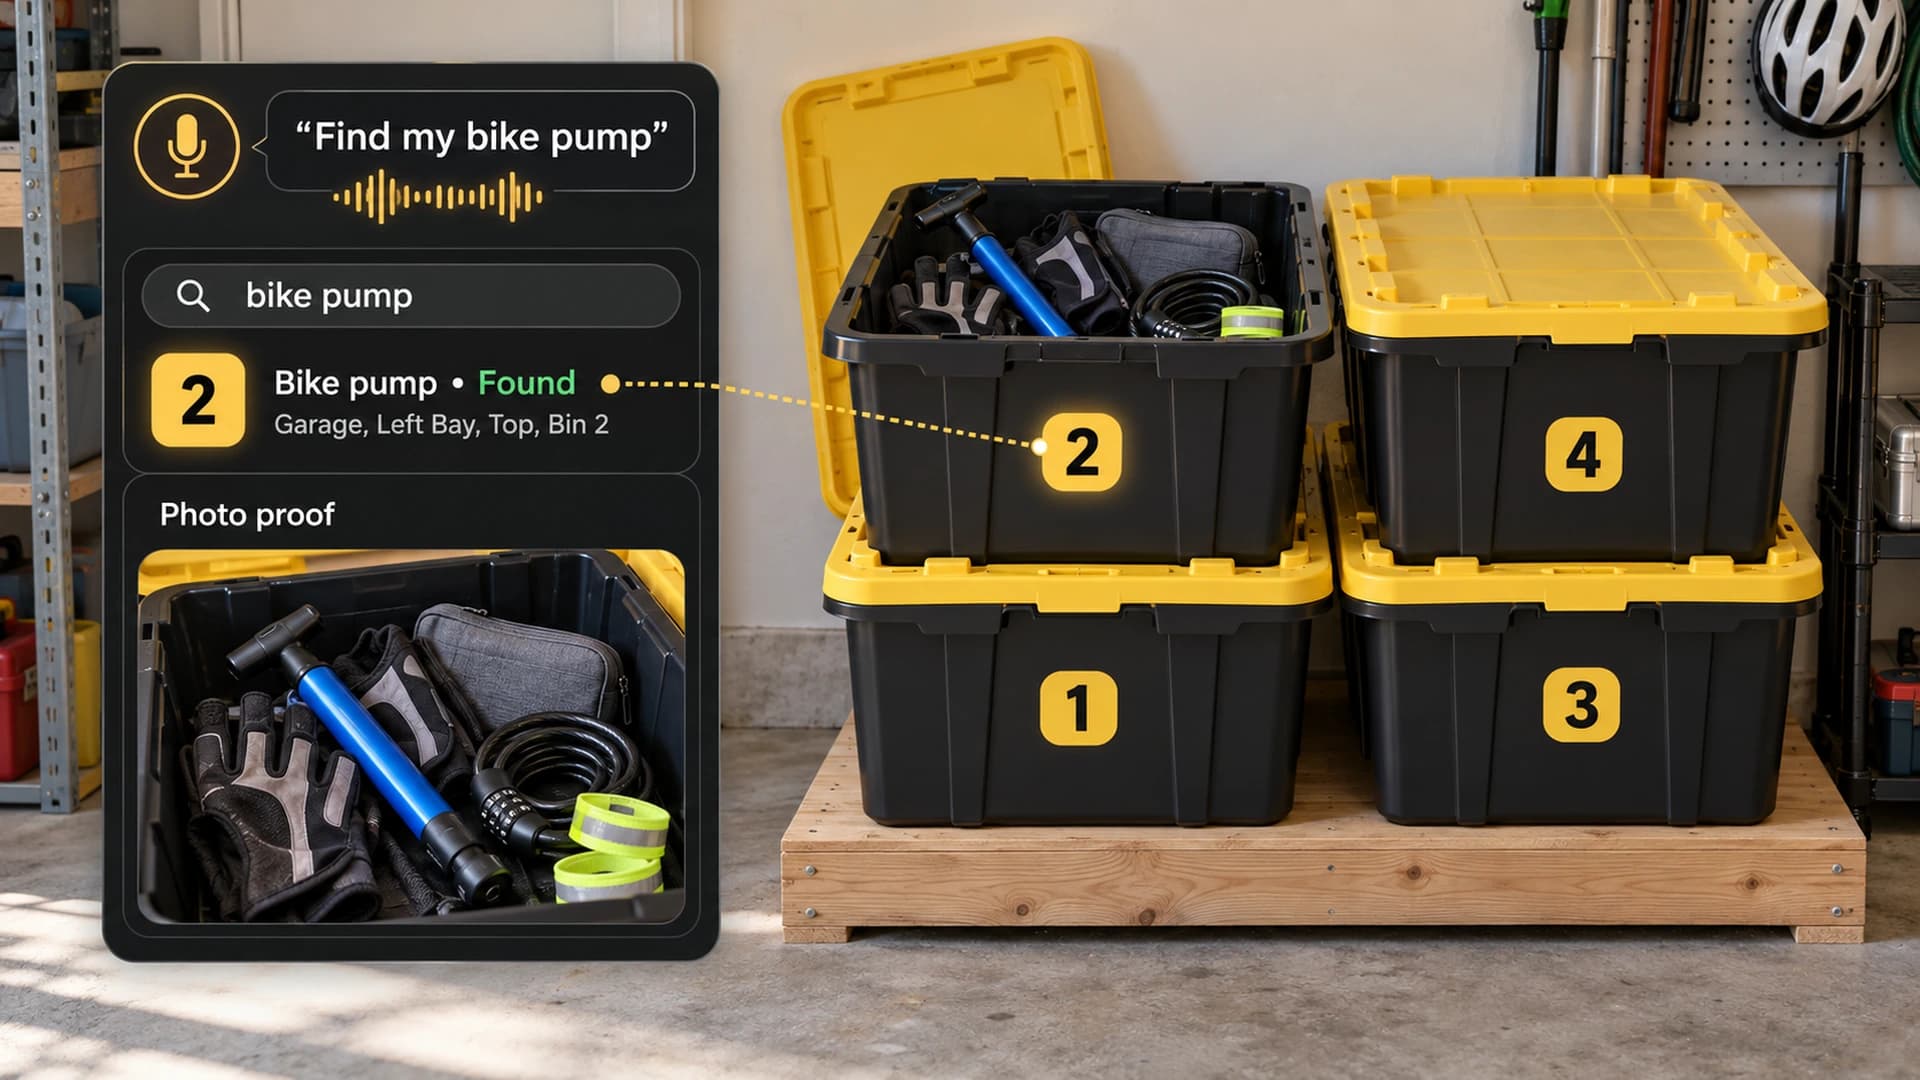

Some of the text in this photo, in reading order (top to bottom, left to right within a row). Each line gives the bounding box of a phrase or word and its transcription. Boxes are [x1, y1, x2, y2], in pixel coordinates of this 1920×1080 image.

[1065, 427, 1100, 477] 2
[1566, 430, 1602, 479] 4
[1066, 683, 1089, 733] 1
[1564, 680, 1600, 730] 3
